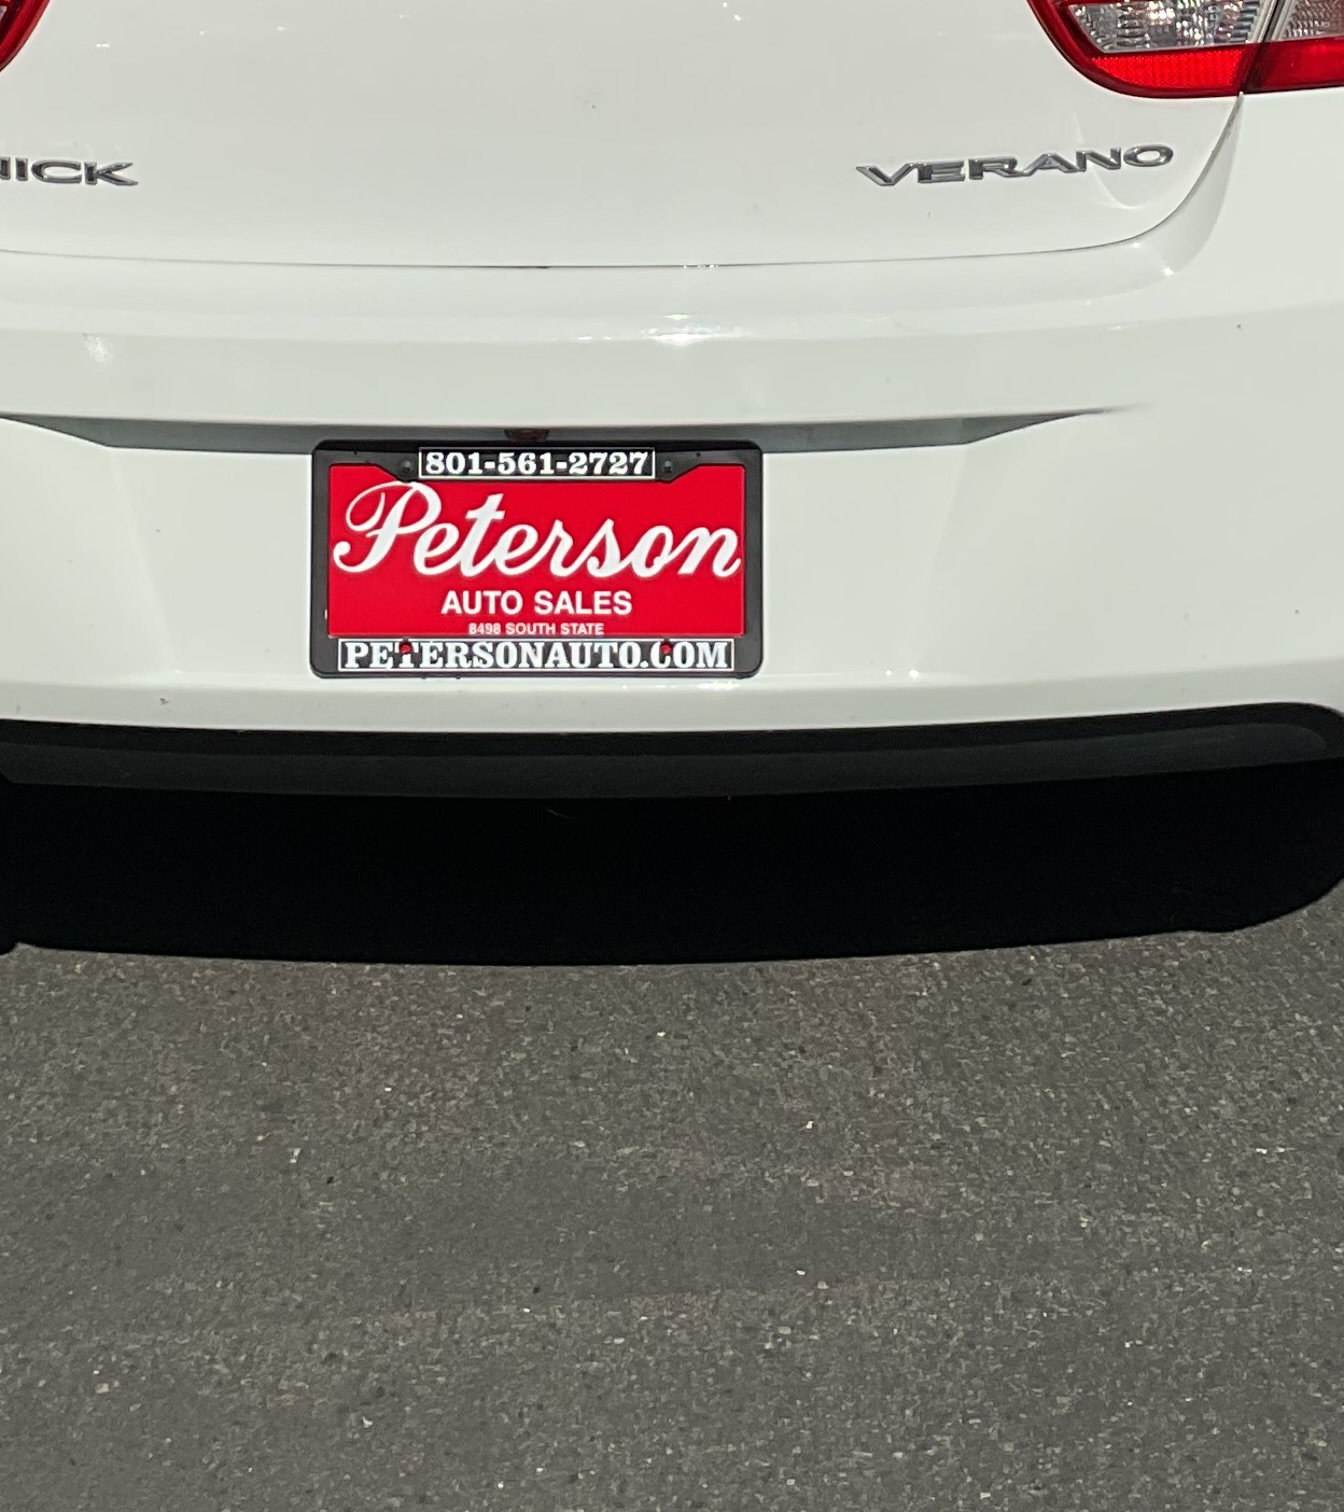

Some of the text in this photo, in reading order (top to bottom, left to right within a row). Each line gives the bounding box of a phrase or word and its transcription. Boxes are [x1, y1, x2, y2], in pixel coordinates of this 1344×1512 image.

[855, 143, 1174, 187] VERANO
[424, 450, 649, 476] 801-561-2727
[332, 479, 742, 578] Peterson
[440, 589, 633, 616] AUTO SALES
[468, 622, 605, 636] 8498 SOUTH STATE
[343, 640, 729, 670] PETERSONAUTO.COM
